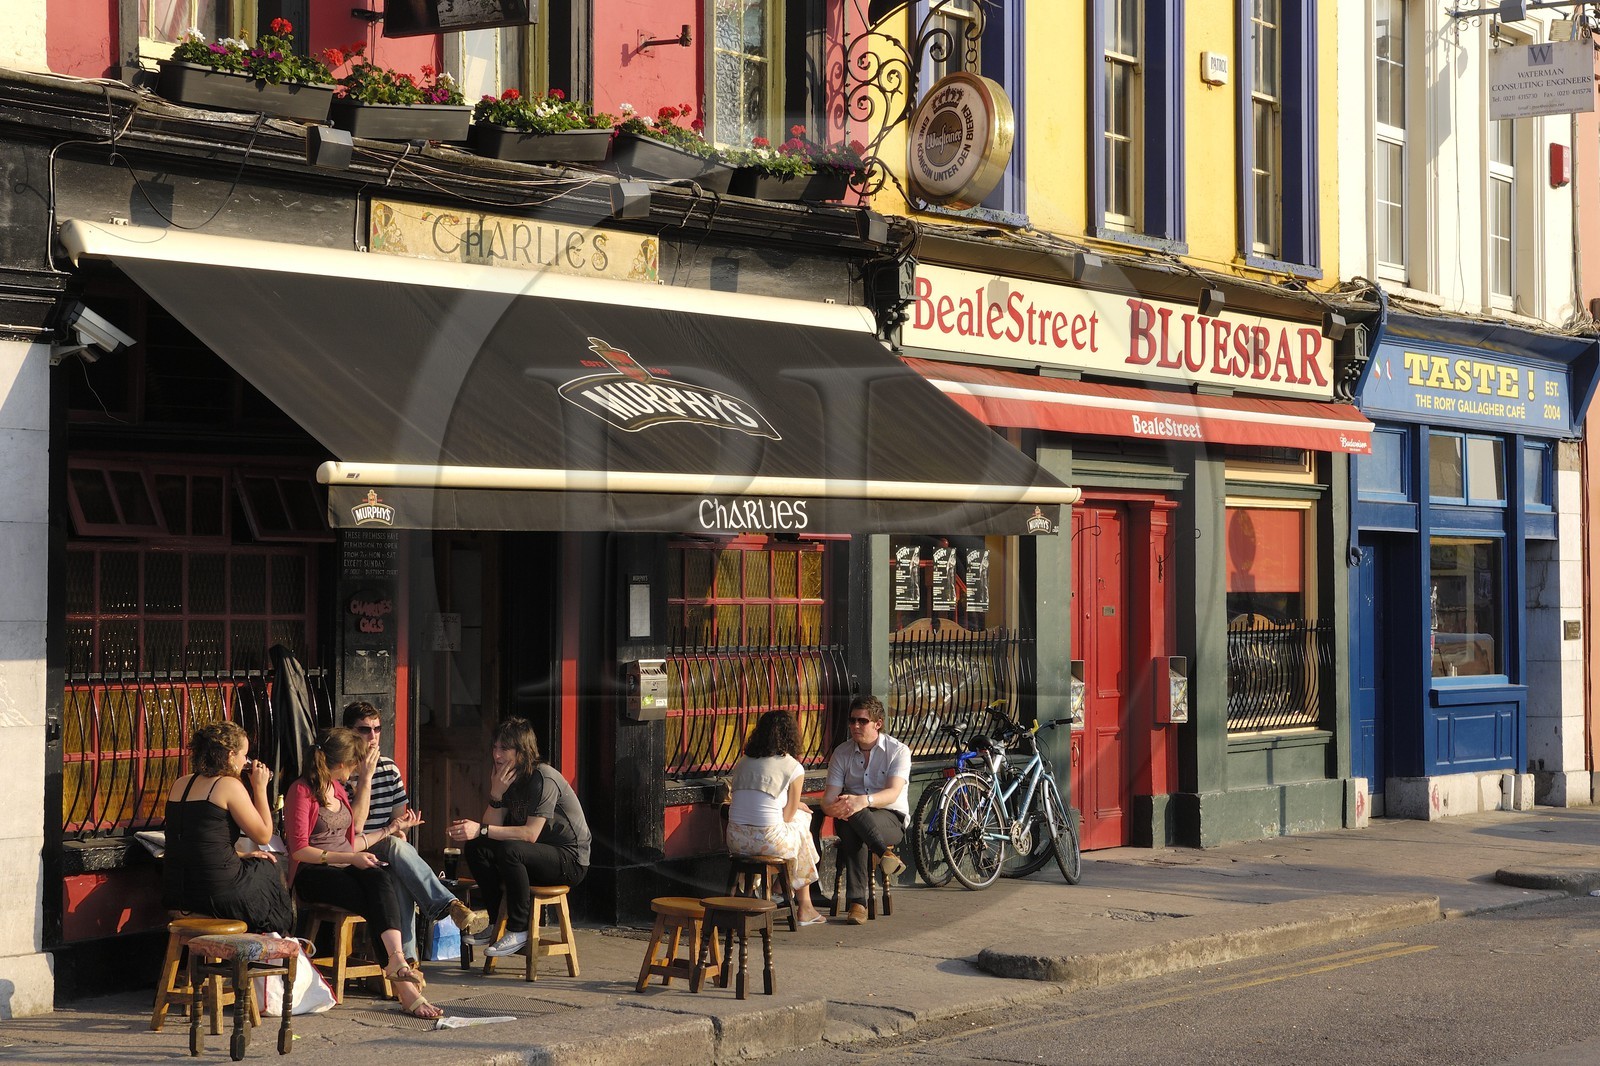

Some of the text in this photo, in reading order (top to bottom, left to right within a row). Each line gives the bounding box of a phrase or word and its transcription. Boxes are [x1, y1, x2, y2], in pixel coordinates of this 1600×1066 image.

[1530, 46, 1551, 64] W
[1518, 68, 1564, 78] WATERMAN
[1492, 76, 1591, 92] CONSULTING ENGINEERS
[917, 104, 974, 182] EINE KÖNIGIN UNTER DEN BIEREN
[913, 276, 1099, 354] BealeStreet
[1545, 380, 1560, 398] EST.
[581, 380, 759, 428] MURPHY'S
[1415, 393, 1526, 419] THE RORY GALLAGHER CAFÉ
[1544, 404, 1561, 420] 2004
[1132, 414, 1202, 439] BealeStreet
[355, 506, 391, 521] MURPHY'S
[344, 531, 360, 539] THESE
[362, 532, 386, 540] PREMISES
[343, 559, 385, 568] EXCEPT SUNDAY
[386, 552, 396, 560] SAT
